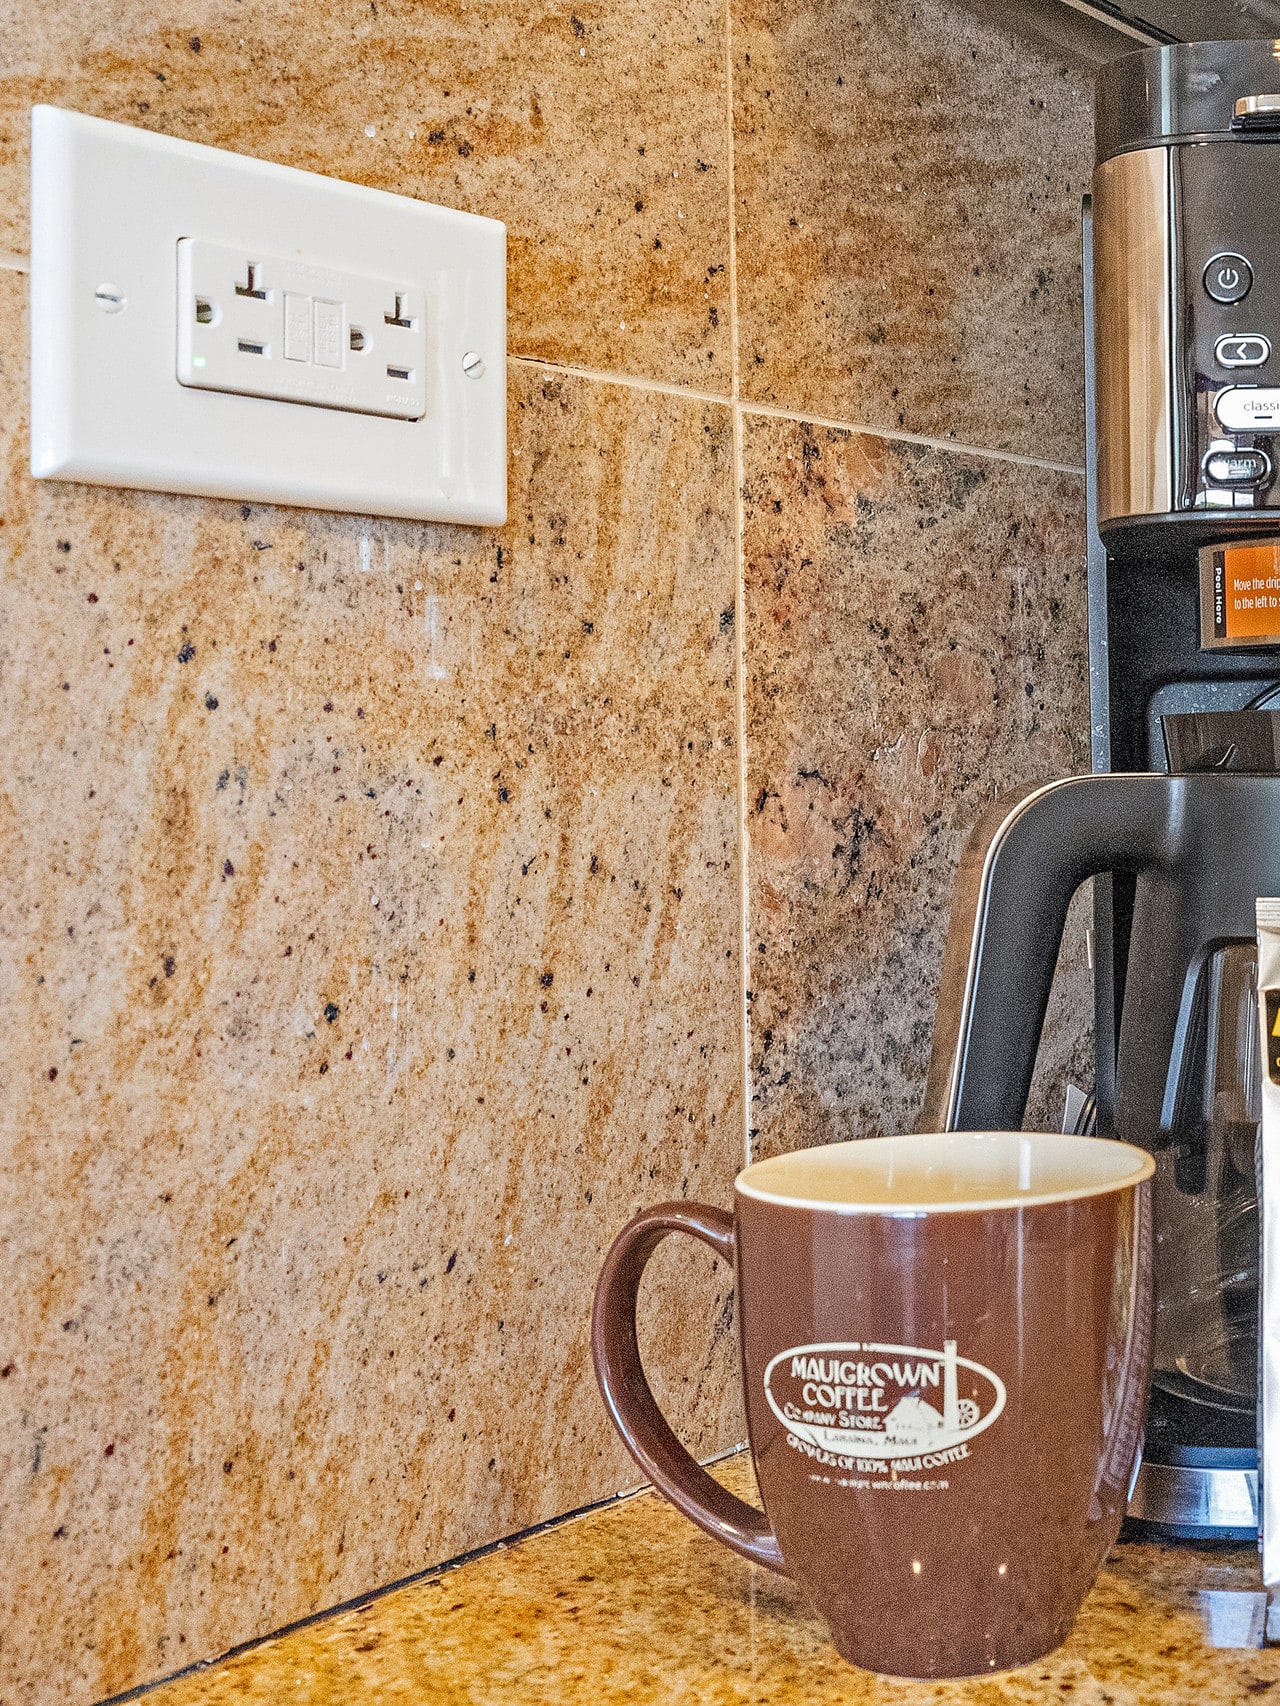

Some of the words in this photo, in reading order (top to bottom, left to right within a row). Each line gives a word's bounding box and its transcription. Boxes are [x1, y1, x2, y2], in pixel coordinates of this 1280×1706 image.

[1233, 578, 1251, 592] Move
[1252, 577, 1265, 590] the
[1234, 598, 1241, 610] to
[1242, 597, 1254, 609] the
[1255, 596, 1267, 608] left
[1269, 596, 1277, 607] to
[791, 1356, 945, 1387] MAUIGROWN
[802, 1382, 889, 1412] COFFEE
